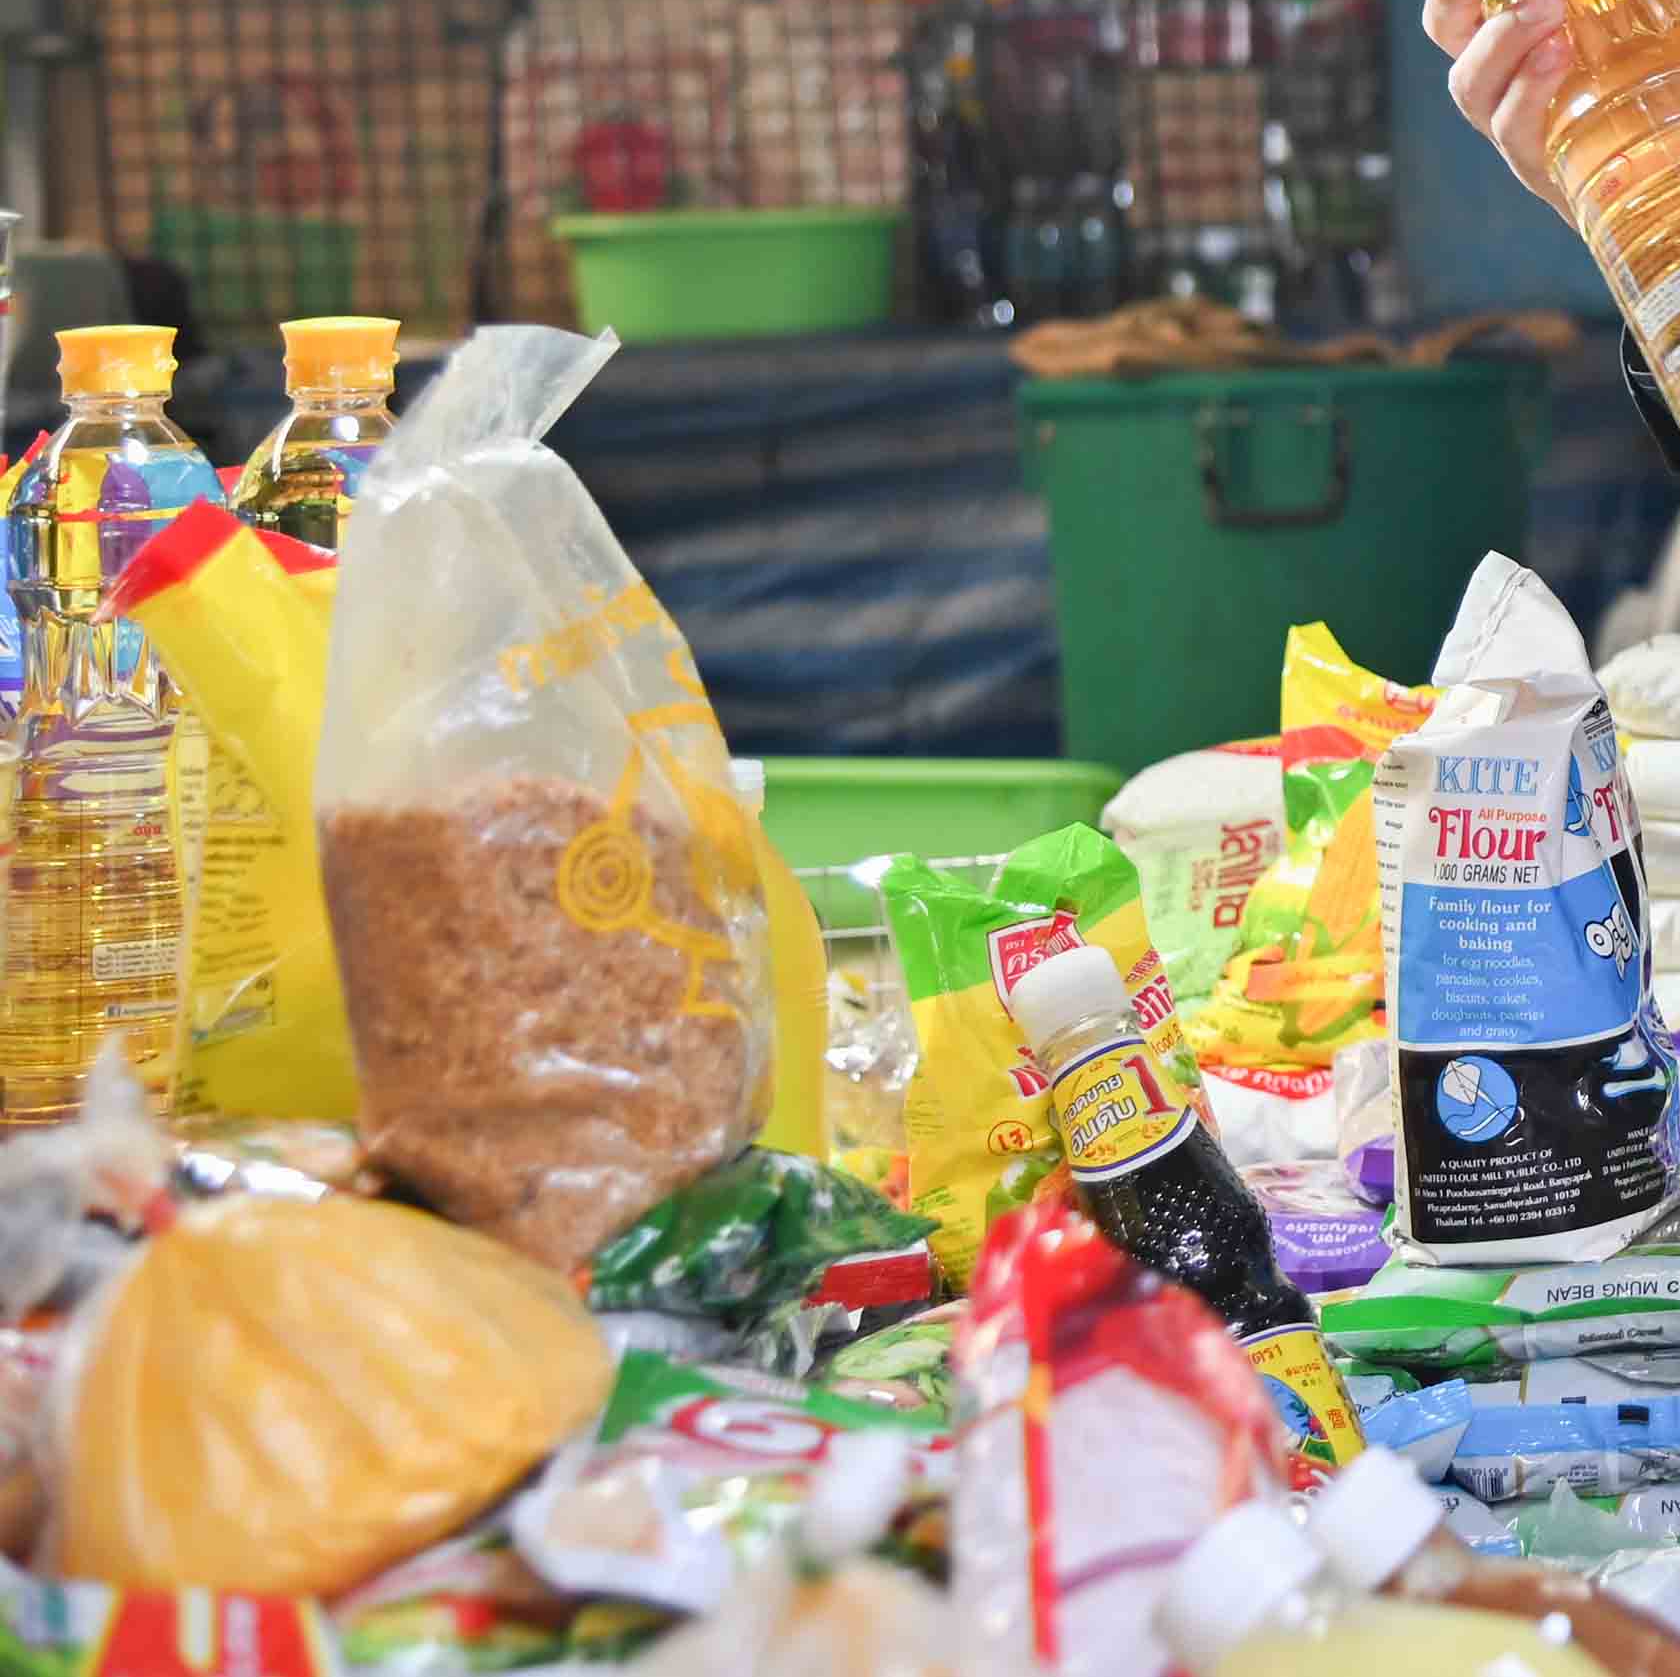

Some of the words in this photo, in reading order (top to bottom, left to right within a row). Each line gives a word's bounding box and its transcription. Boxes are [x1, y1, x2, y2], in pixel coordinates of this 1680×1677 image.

[1435, 756, 1540, 795] KITE
[1478, 808, 1495, 821] All
[1496, 809, 1547, 824] Purpose
[1428, 806, 1547, 861] Flour
[1463, 864, 1508, 883] GRAMS
[1513, 866, 1540, 884] NET
[1429, 896, 1476, 914] Family
[1481, 900, 1520, 914] flour
[1527, 900, 1552, 912] for
[1439, 919, 1499, 935] cooking
[1505, 918, 1537, 931] and
[1459, 936, 1513, 952] baking
[1494, 974, 1544, 987] cookies,
[1459, 1025, 1482, 1037] and
[1486, 1026, 1519, 1039] gravy
[1071, 1095, 1137, 1157] อันดับ
[1120, 1055, 1177, 1115] 1
[1440, 1161, 1447, 1169] A
[1448, 1157, 1487, 1170] QUALITY
[1490, 1151, 1537, 1166] PRODUCT
[1540, 1148, 1553, 1158] OF
[1419, 1173, 1447, 1183] UNITED
[1449, 1172, 1478, 1183] FLOUR
[1481, 1171, 1503, 1181] MILL
[1506, 1166, 1540, 1179] PUBLIC
[1564, 1157, 1582, 1169] LTD
[1554, 1188, 1581, 1201] 10130
[1435, 1217, 1468, 1226] Thailand
[1547, 1284, 1595, 1303] BEAN
[1602, 1281, 1658, 1297] MUNG
